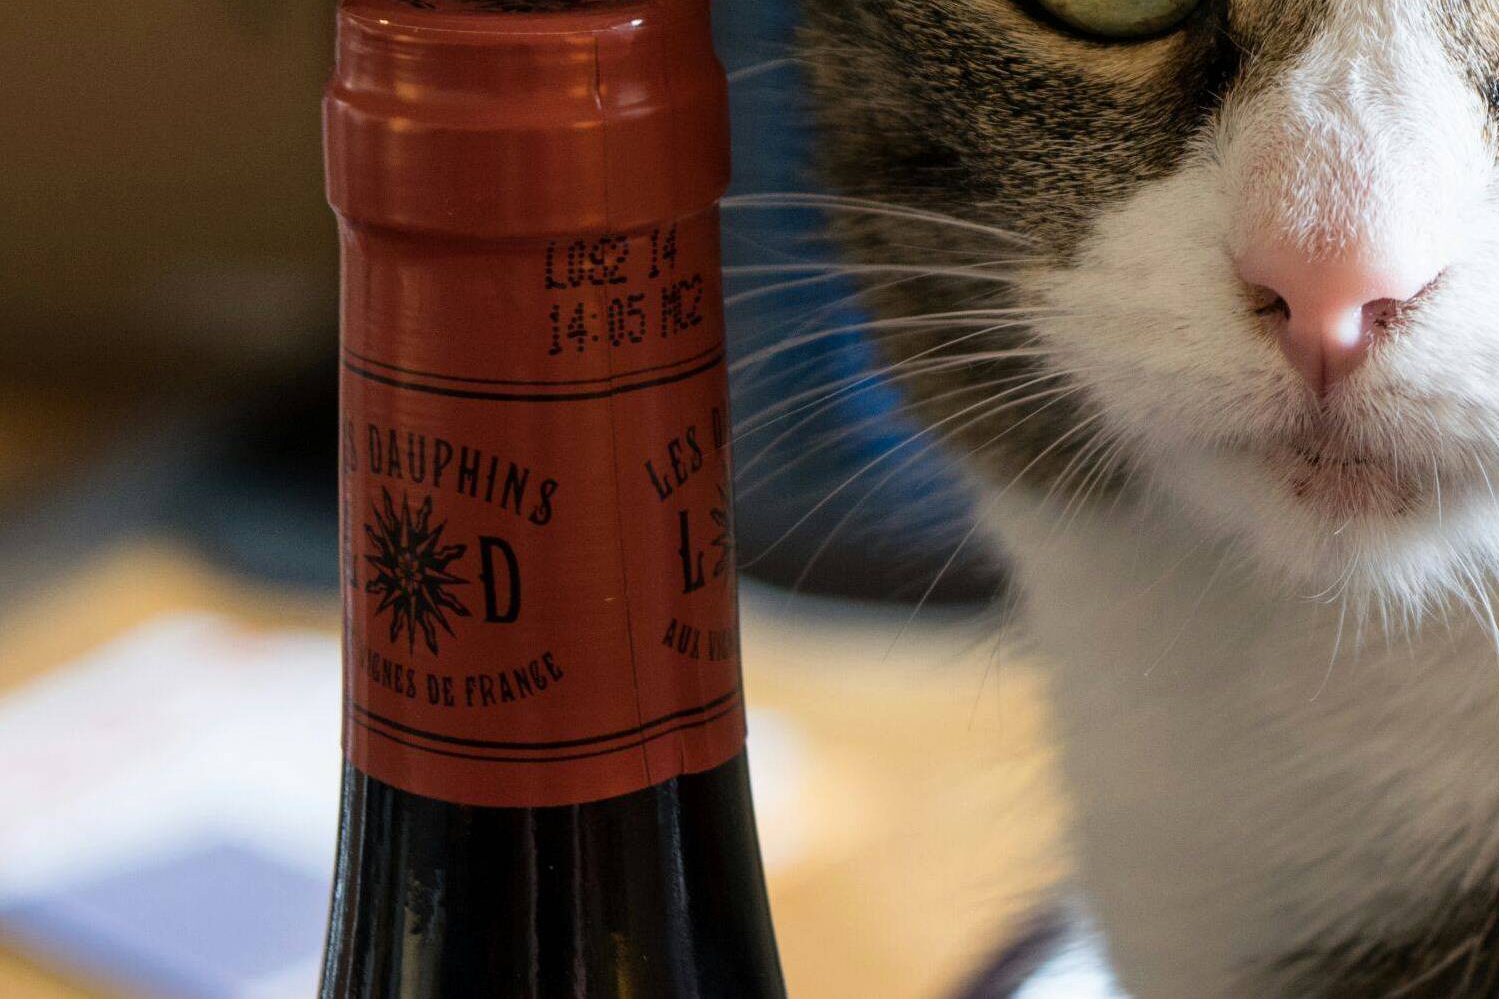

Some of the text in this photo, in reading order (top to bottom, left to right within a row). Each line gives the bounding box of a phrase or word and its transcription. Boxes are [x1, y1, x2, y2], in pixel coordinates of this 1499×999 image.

[368, 423, 559, 526] DAUPHINS
[644, 425, 704, 501] LES
[479, 535, 521, 624] D
[426, 674, 455, 707] DE
[465, 651, 565, 707] FRANCE
